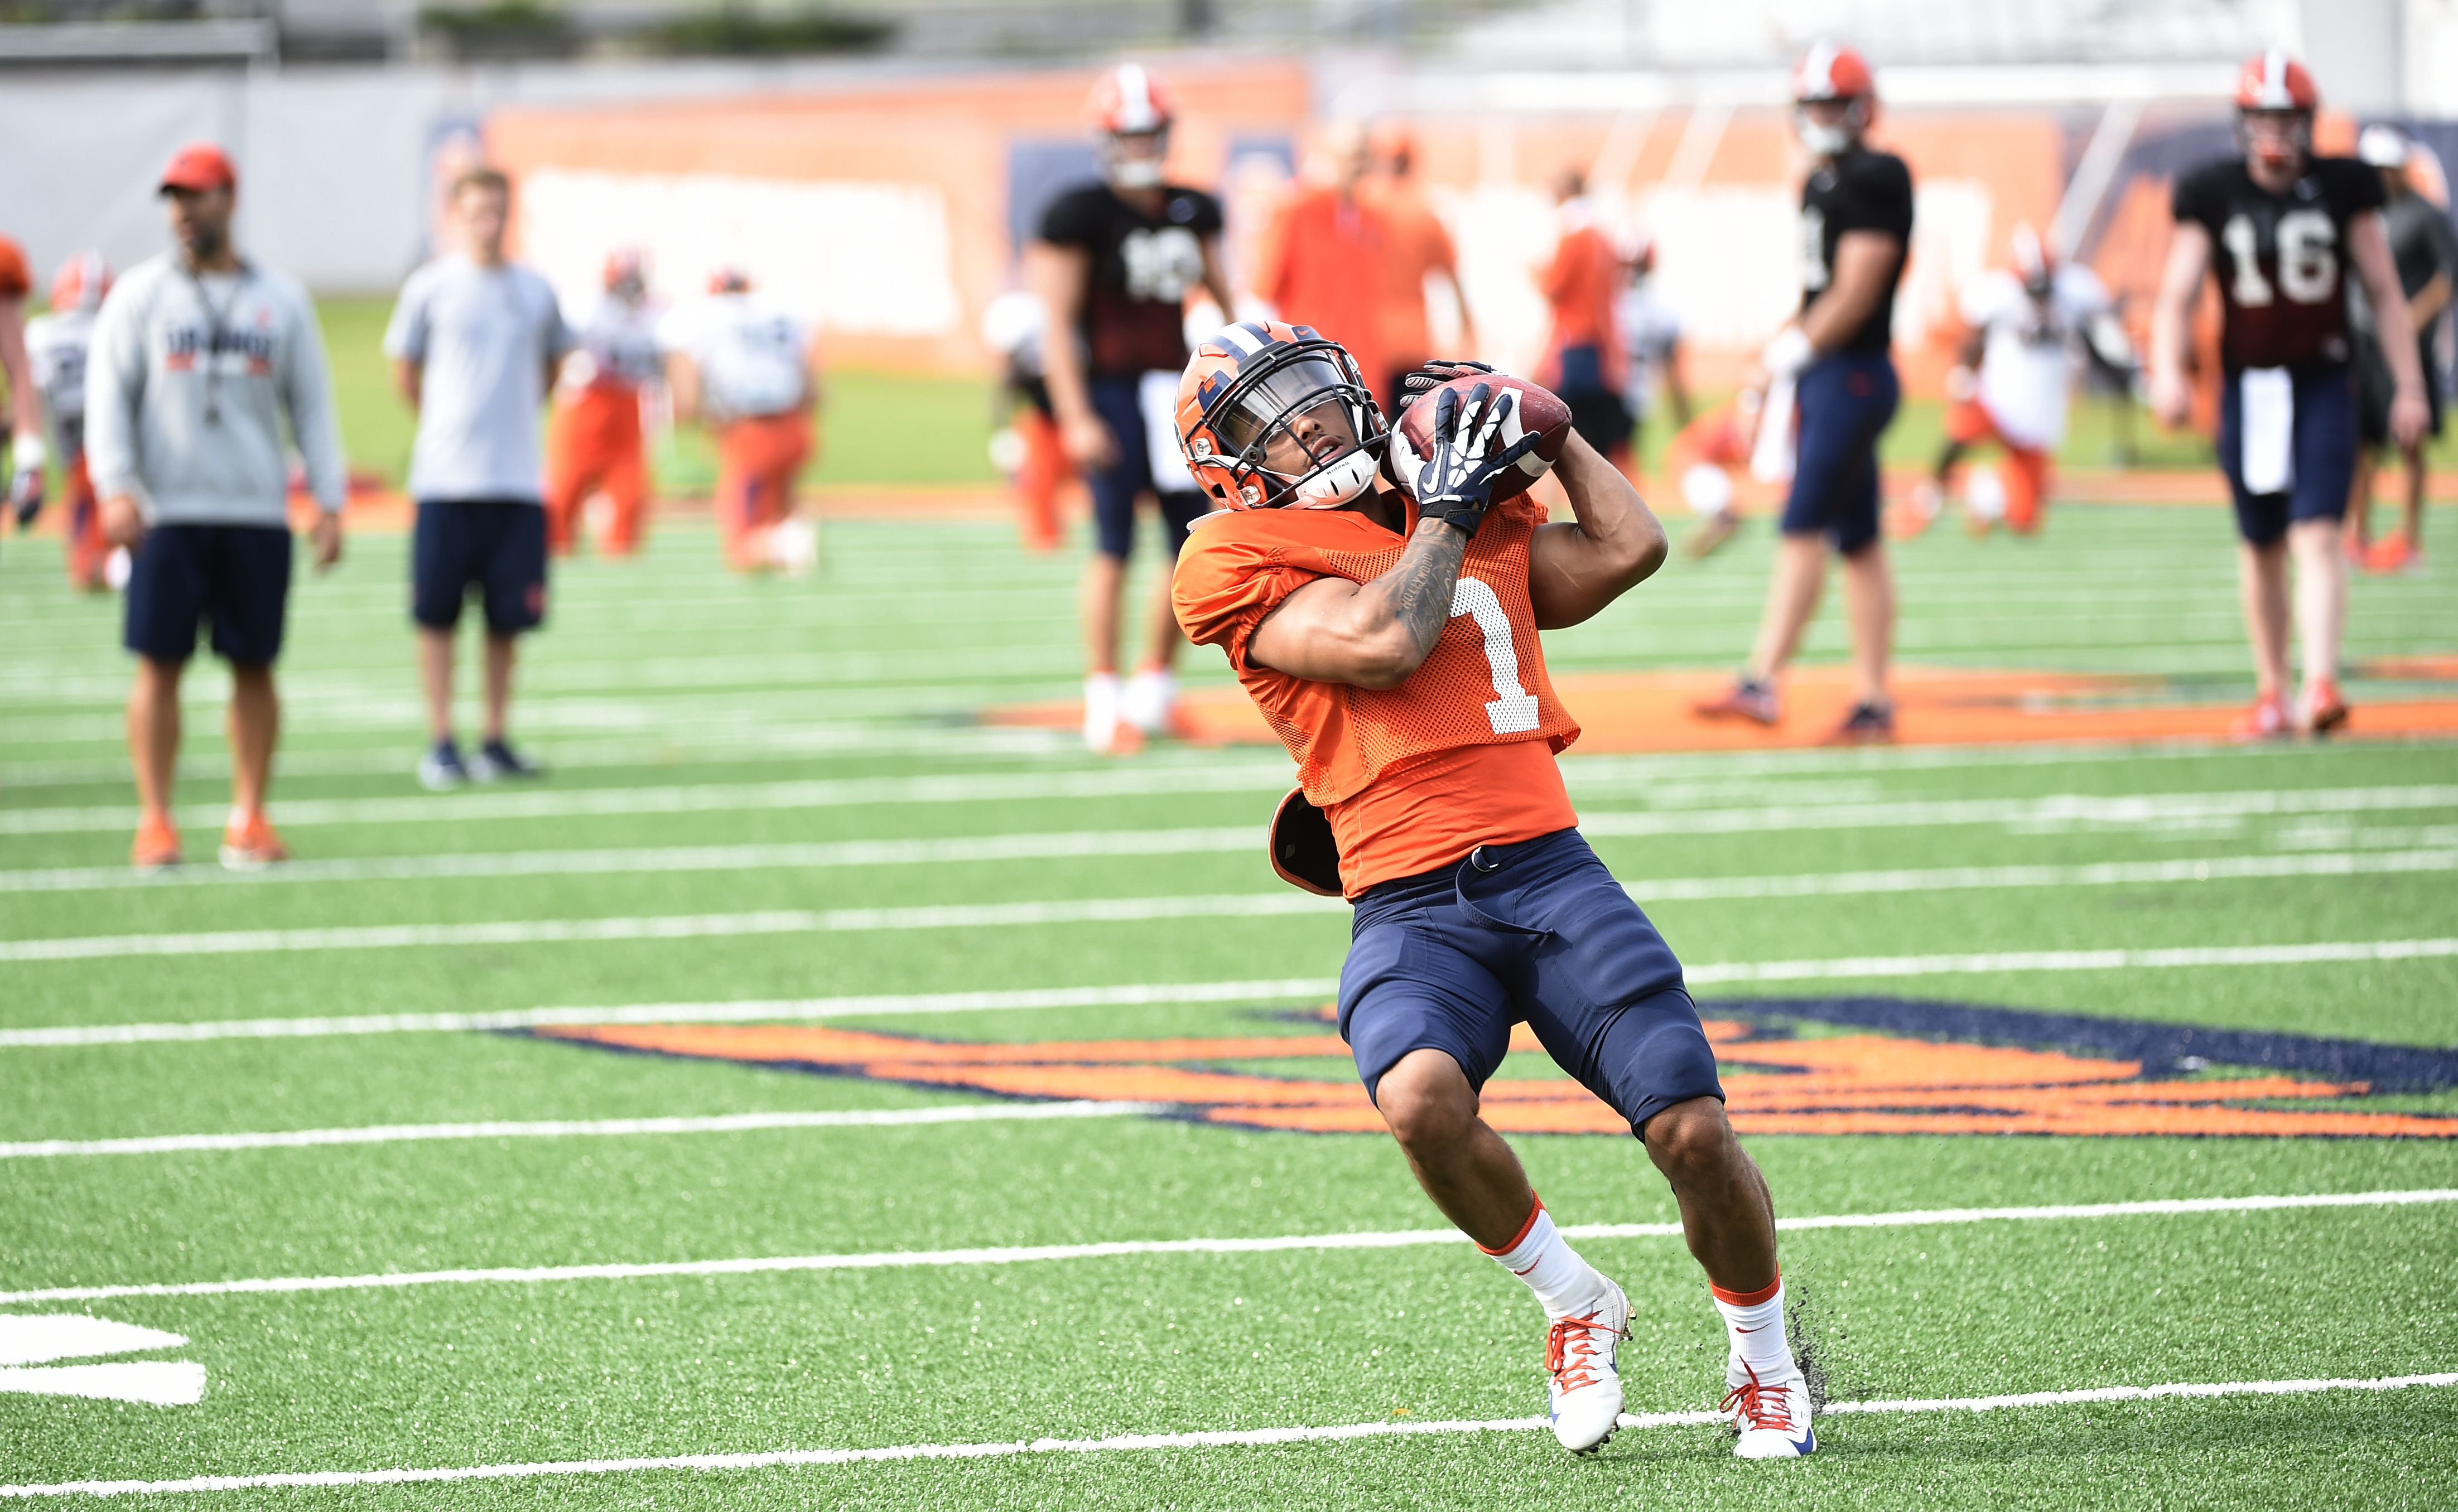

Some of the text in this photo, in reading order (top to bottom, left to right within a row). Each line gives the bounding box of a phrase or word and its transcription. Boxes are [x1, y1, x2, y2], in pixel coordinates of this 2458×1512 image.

[2223, 209, 2337, 308] 16
[1327, 461, 1350, 475] Riddell
[1401, 553, 1433, 610] HOLLYWOOD
[1450, 576, 1539, 734] 1
